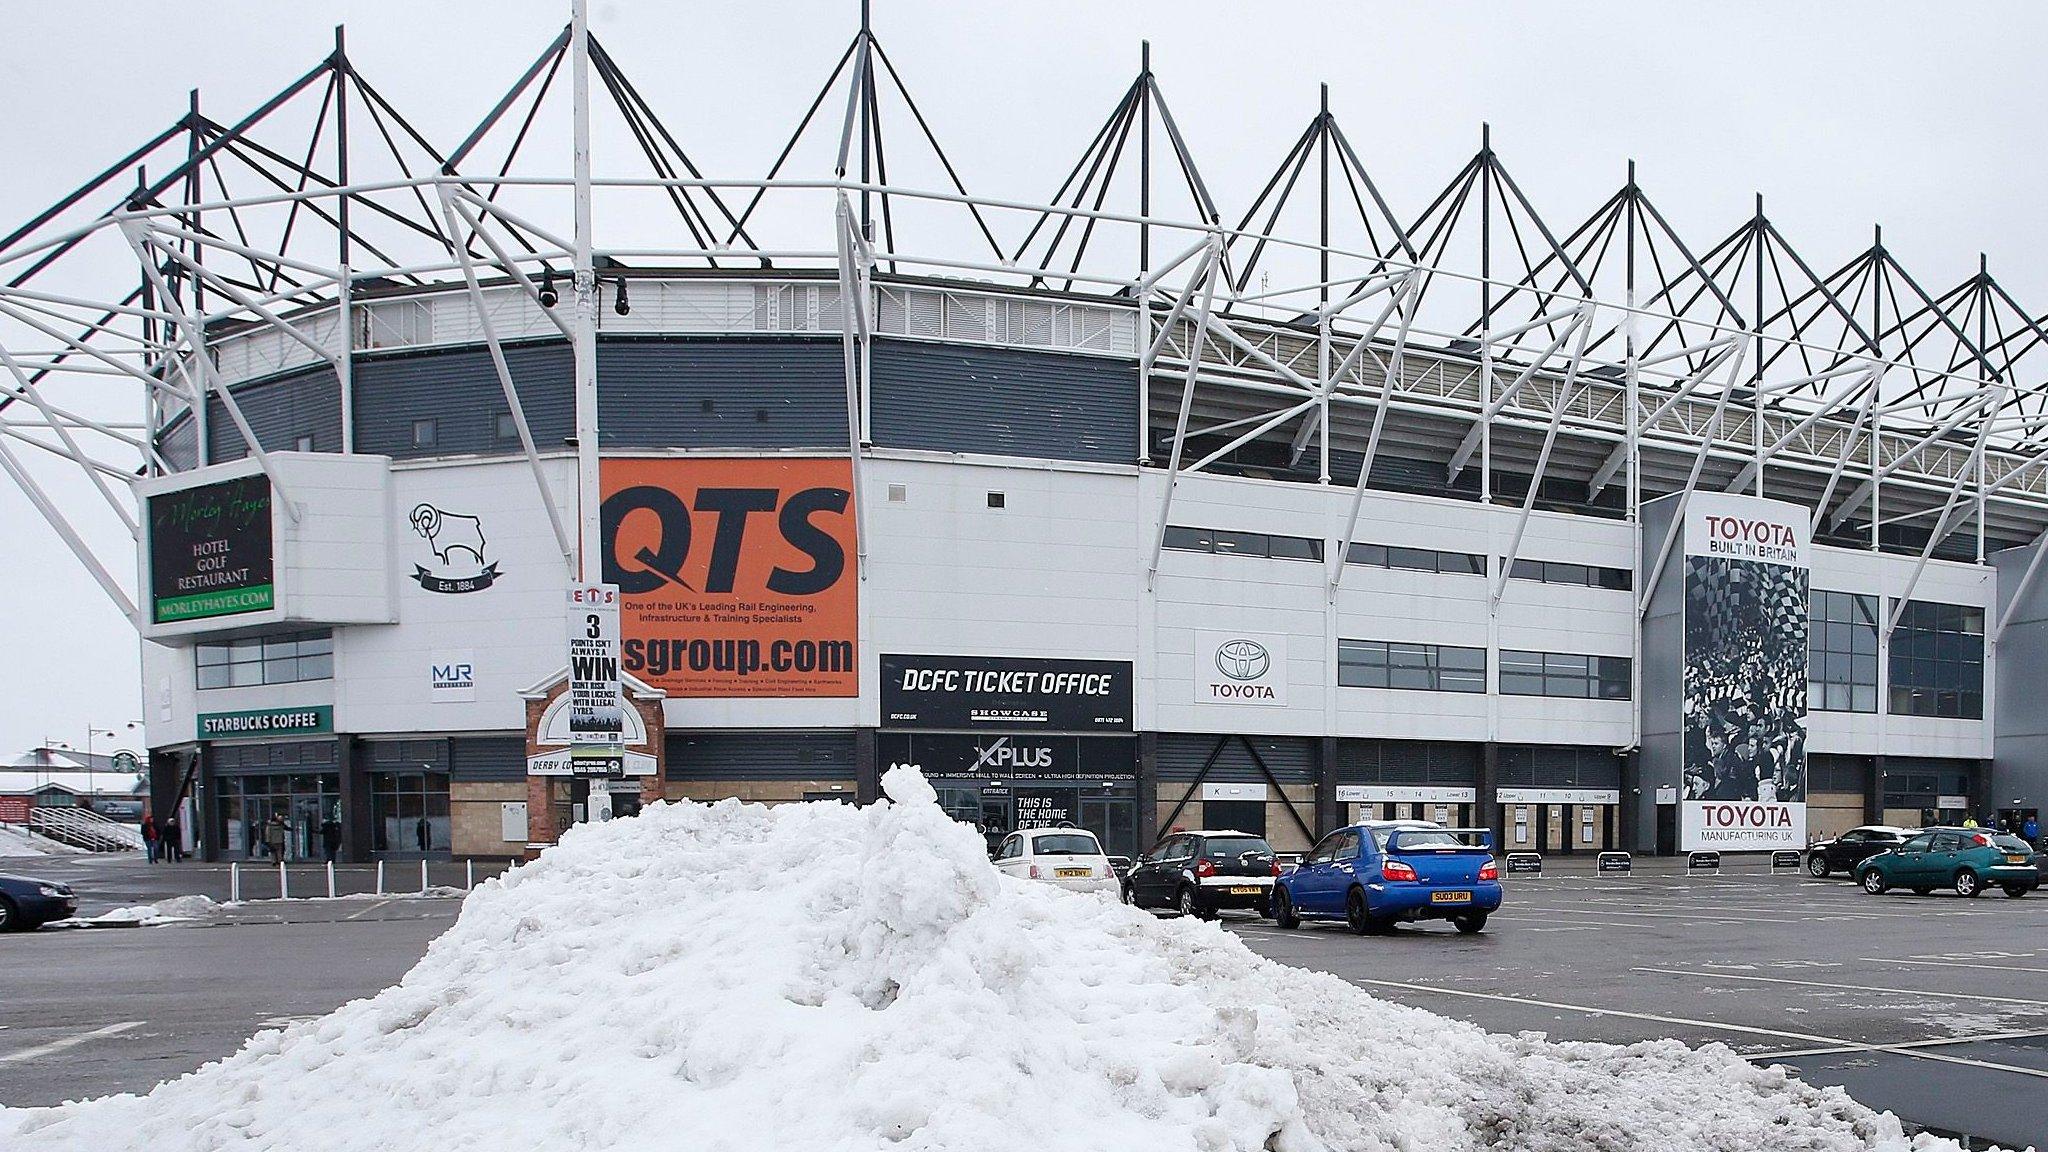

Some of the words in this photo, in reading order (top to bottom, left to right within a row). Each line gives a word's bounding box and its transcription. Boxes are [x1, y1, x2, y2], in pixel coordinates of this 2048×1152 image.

[1706, 516, 1796, 548] TOYOTA
[193, 540, 230, 556] HOTEL
[600, 486, 850, 595] QTS
[1710, 541, 1742, 554] BUILT
[1746, 544, 1756, 556] IN
[1758, 546, 1796, 562] BRITAIN
[197, 556, 227, 572] GOLF
[178, 568, 249, 590] RESTAURANT
[438, 582, 454, 592] Est.
[457, 581, 475, 590] 1884
[160, 592, 269, 616] MORLEYHAYES.COM
[624, 602, 644, 610] One
[646, 602, 656, 610] of
[658, 602, 673, 610] the
[675, 602, 696, 610] UK's
[700, 603, 736, 612] Leading
[758, 604, 817, 612] Engineering,
[586, 614, 600, 638] 3
[640, 614, 701, 622] Infrastructure
[714, 615, 752, 624] Training
[752, 615, 802, 624] Specialists
[570, 639, 594, 648] POINTS
[572, 648, 600, 656] ALWAYS
[601, 648, 606, 656] A
[621, 639, 853, 676] sgroup.com
[572, 656, 617, 682] WIN
[590, 682, 606, 690] RISK
[902, 668, 960, 692] DCFC
[964, 670, 1038, 693] TICKET
[1040, 672, 1112, 696] OFFICE
[572, 690, 590, 698] YOUR
[592, 690, 616, 698] LICENSE
[1210, 684, 1275, 698] TOYOTA
[204, 715, 270, 732] STARBUCKS
[272, 712, 317, 729] COFFEE
[968, 737, 1052, 772] XPLUS
[532, 760, 559, 770] DERBY
[562, 760, 572, 770] CO
[1338, 789, 1346, 797] 16
[1018, 798, 1040, 808] THIS
[1042, 798, 1052, 808] IS
[1018, 808, 1036, 819] THE
[1038, 809, 1068, 819] HOME
[1702, 805, 1792, 827] TOYOTA
[1018, 820, 1032, 830] OF
[1032, 820, 1051, 828] THE
[1702, 832, 1778, 841] MANUFACTURING
[1781, 832, 1793, 841] UK
